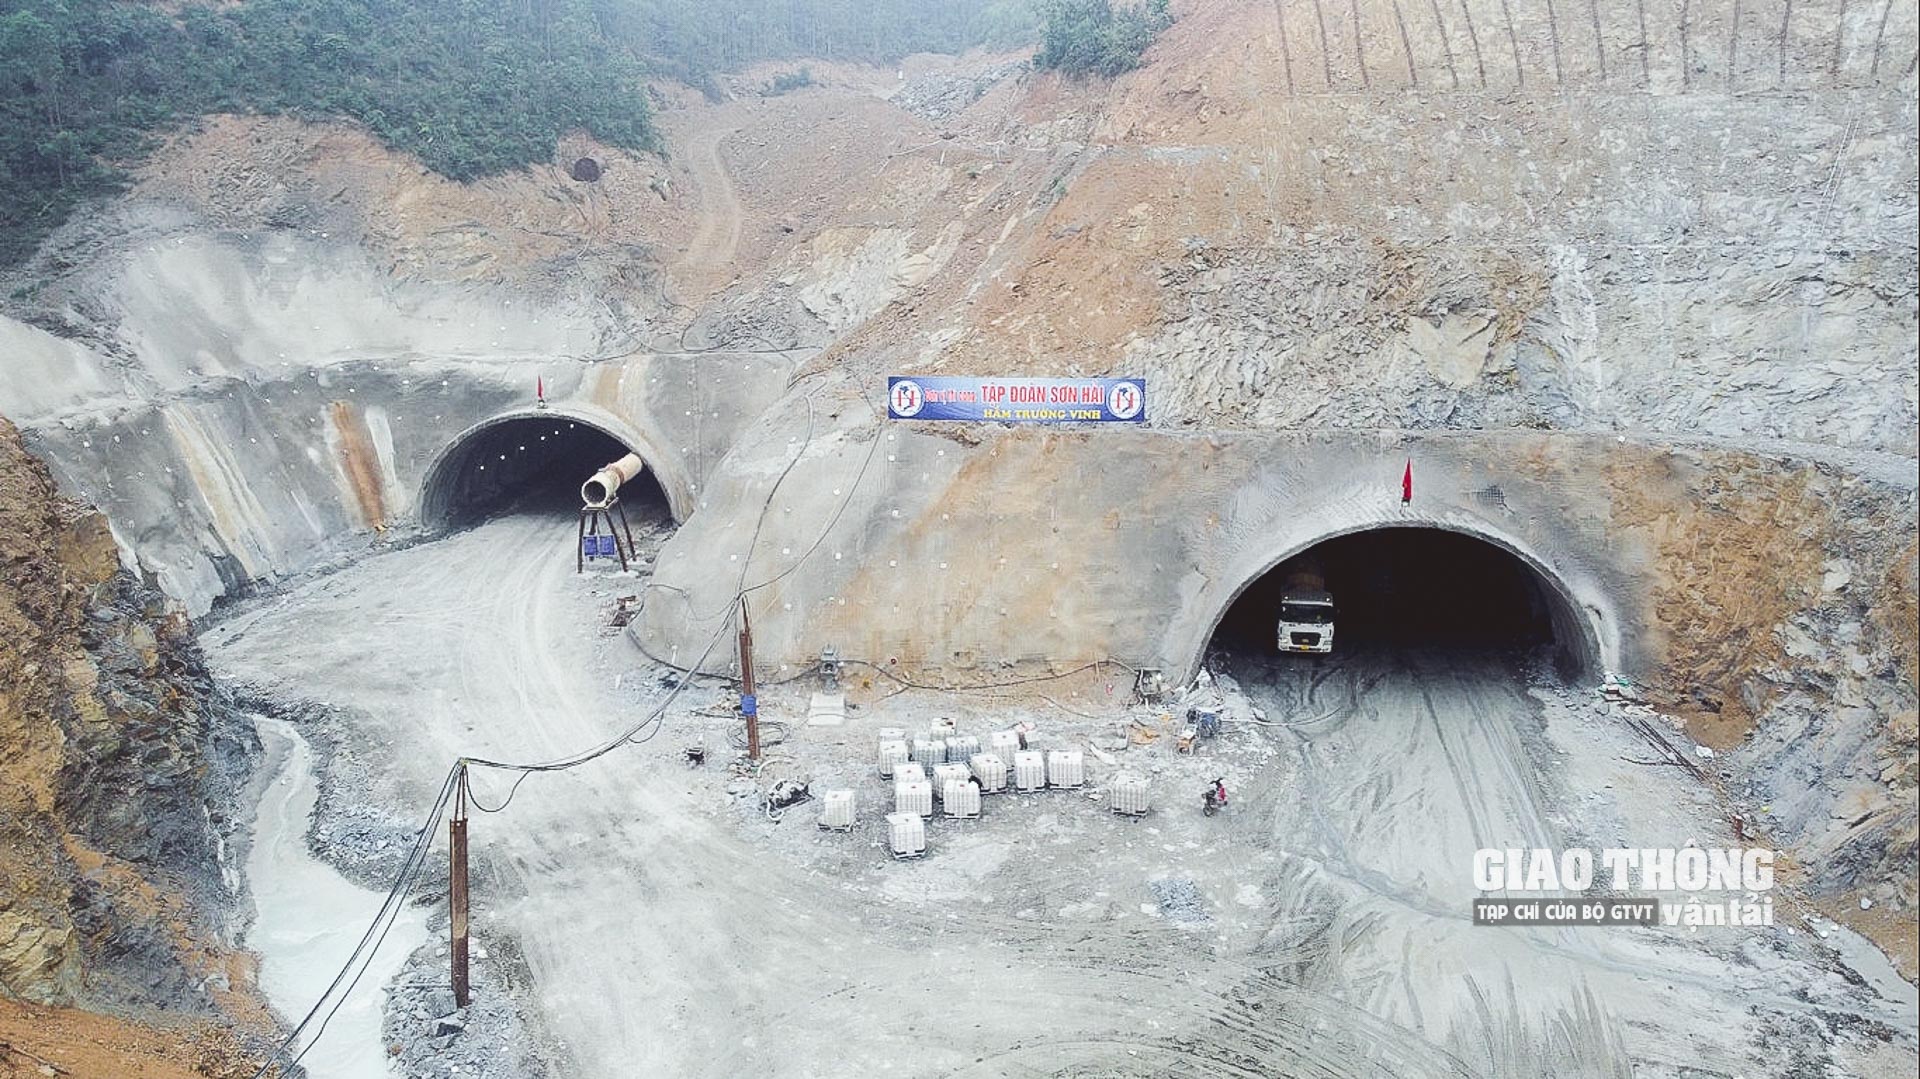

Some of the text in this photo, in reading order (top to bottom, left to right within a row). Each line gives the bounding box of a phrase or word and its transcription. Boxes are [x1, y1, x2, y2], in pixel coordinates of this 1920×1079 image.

[982, 382, 1005, 406] TẬP
[1010, 382, 1046, 403] ĐOÀN
[1050, 384, 1077, 403] SƠN
[1082, 381, 1104, 404] HẢI
[1070, 409, 1101, 420] VINH
